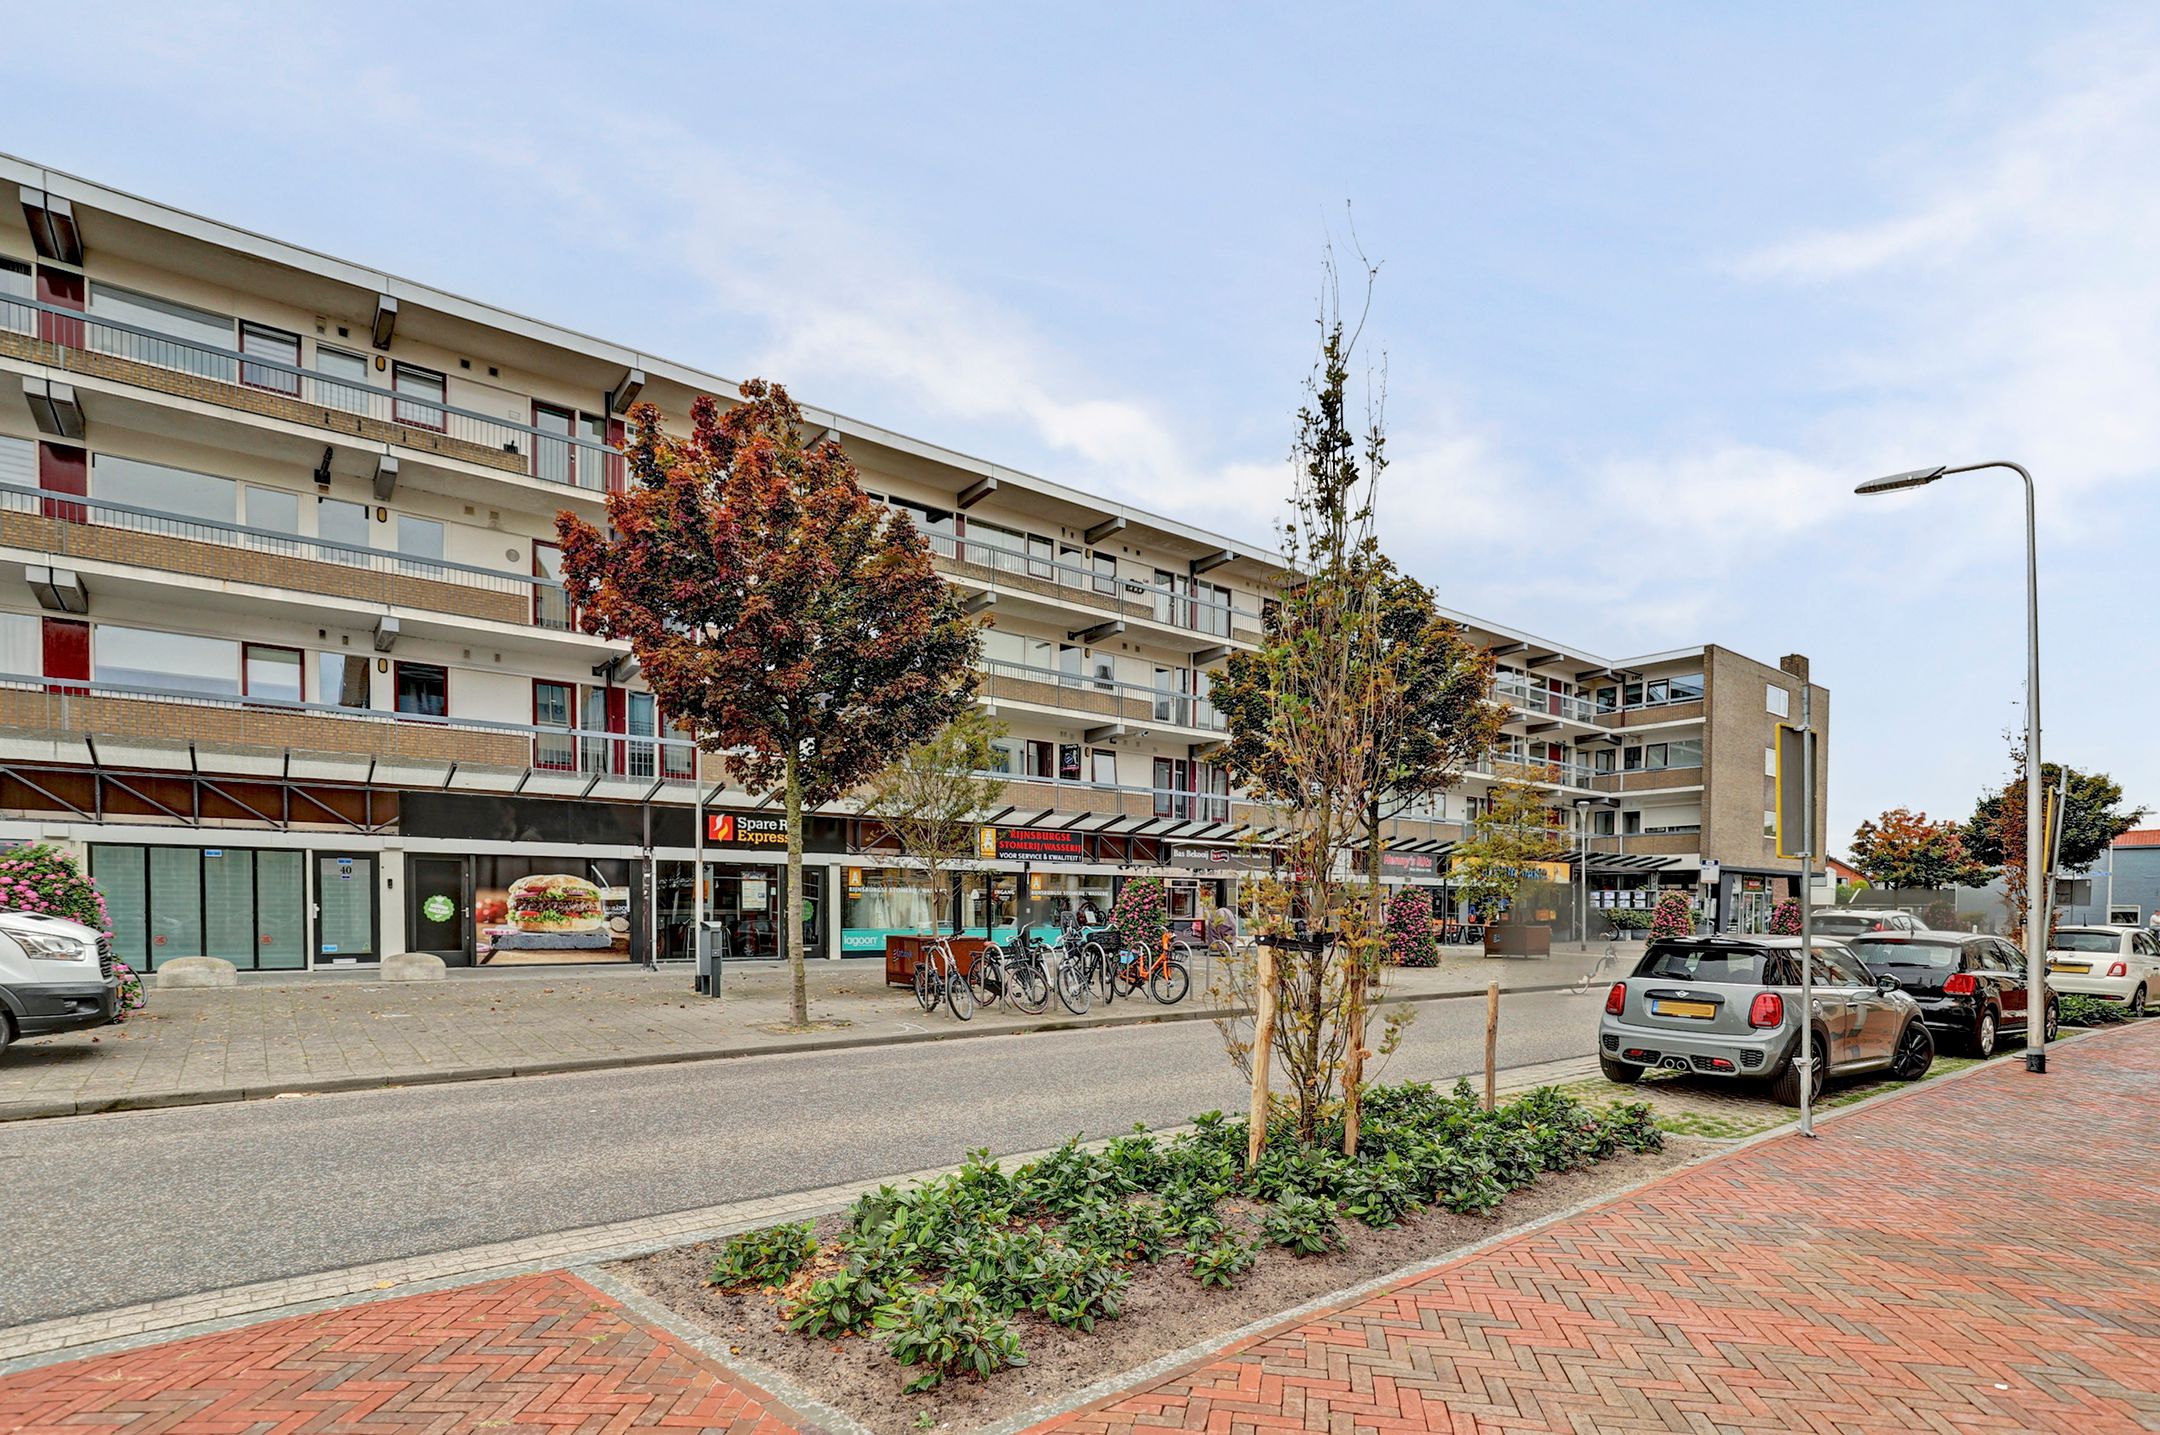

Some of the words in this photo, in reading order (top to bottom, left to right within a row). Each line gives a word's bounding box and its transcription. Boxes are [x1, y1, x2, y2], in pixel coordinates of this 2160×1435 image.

[737, 816, 777, 831] Spare
[1010, 830, 1072, 842] RIJNSBURGSE
[999, 841, 1082, 853] STOMERIJ/WASSERIJ
[1173, 850, 1185, 858] Bas
[340, 866, 352, 874] 40
